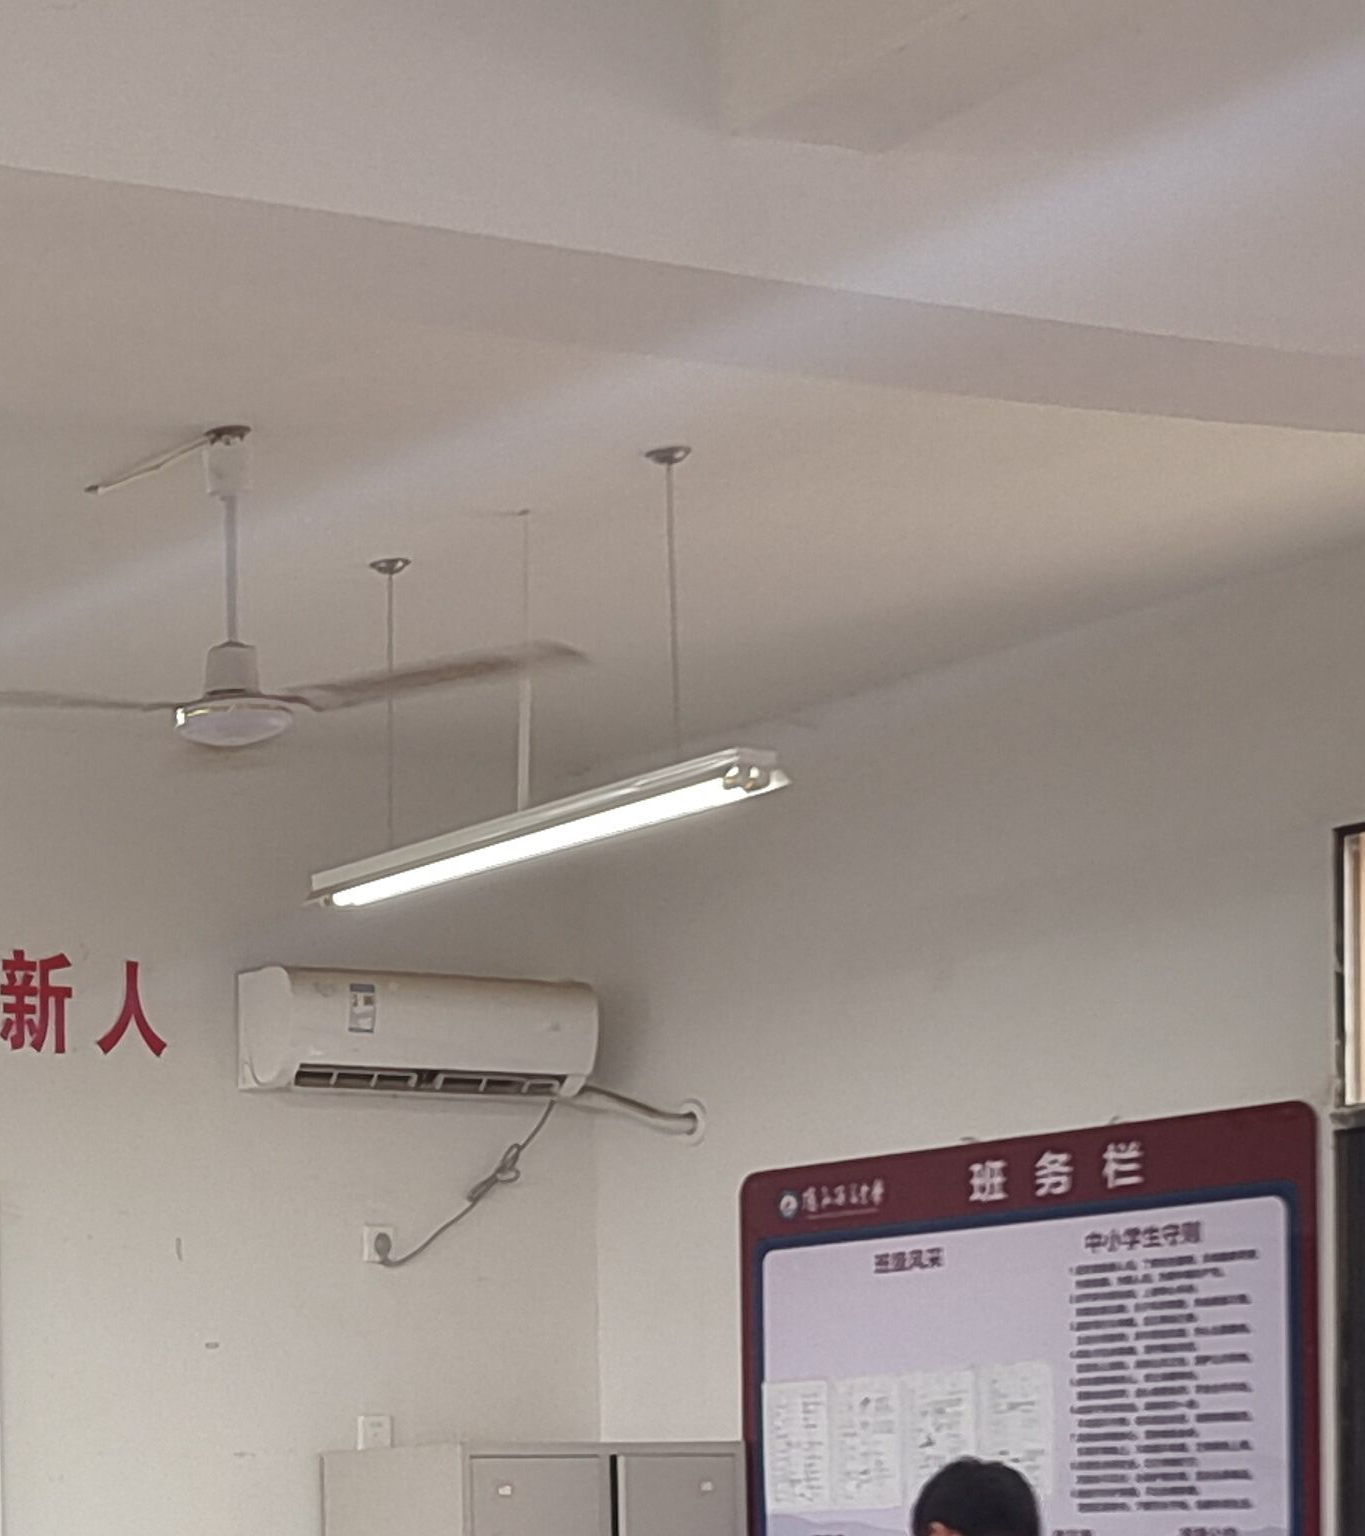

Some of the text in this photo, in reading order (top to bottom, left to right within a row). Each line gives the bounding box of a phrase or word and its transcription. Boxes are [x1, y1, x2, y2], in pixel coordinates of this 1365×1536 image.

[967, 1141, 1145, 1202] 班务栏
[1084, 1220, 1201, 1253] 中小学生守则
